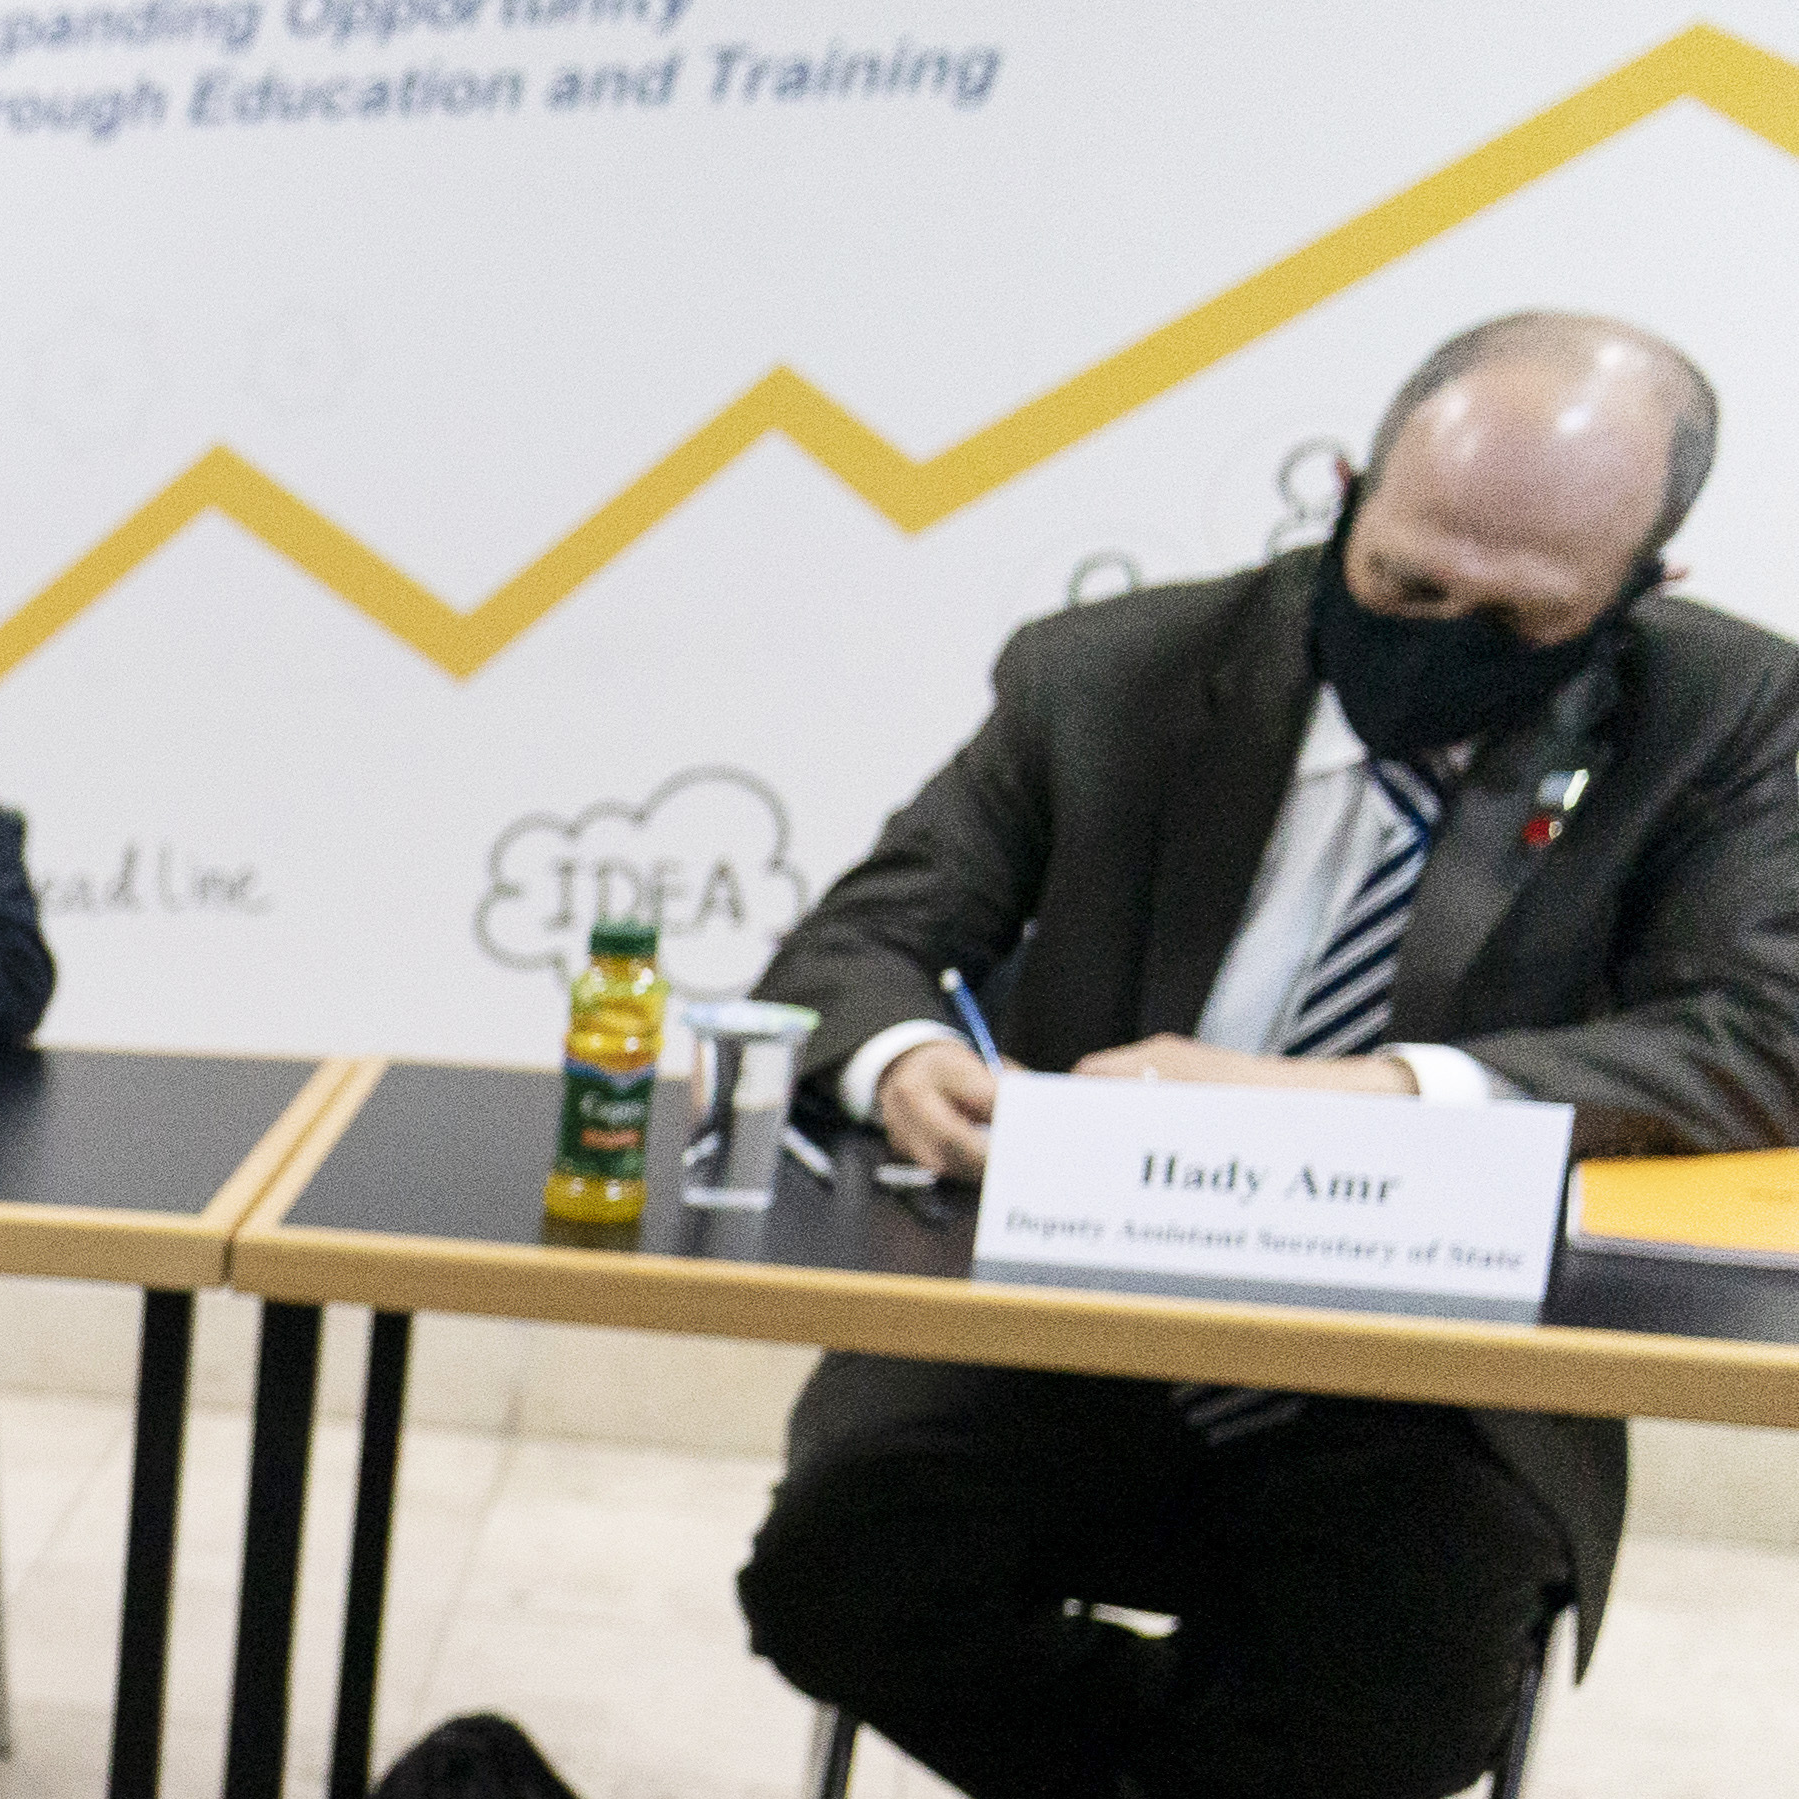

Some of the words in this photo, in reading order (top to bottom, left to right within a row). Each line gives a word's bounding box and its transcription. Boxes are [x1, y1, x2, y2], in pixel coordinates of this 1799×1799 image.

[187, 66, 522, 130] Education
[545, 50, 680, 112] and
[704, 40, 1002, 110] Training
[36, 842, 270, 918] eadline
[548, 856, 748, 934] IDEA
[1141, 1149, 1271, 1206] Hady
[1286, 1170, 1402, 1207] Amr
[1005, 1209, 1108, 1244] Deputy
[1120, 1215, 1249, 1251] Assistant
[1253, 1228, 1398, 1269] Secretary
[1407, 1238, 1441, 1267] of
[1447, 1240, 1525, 1273] State
